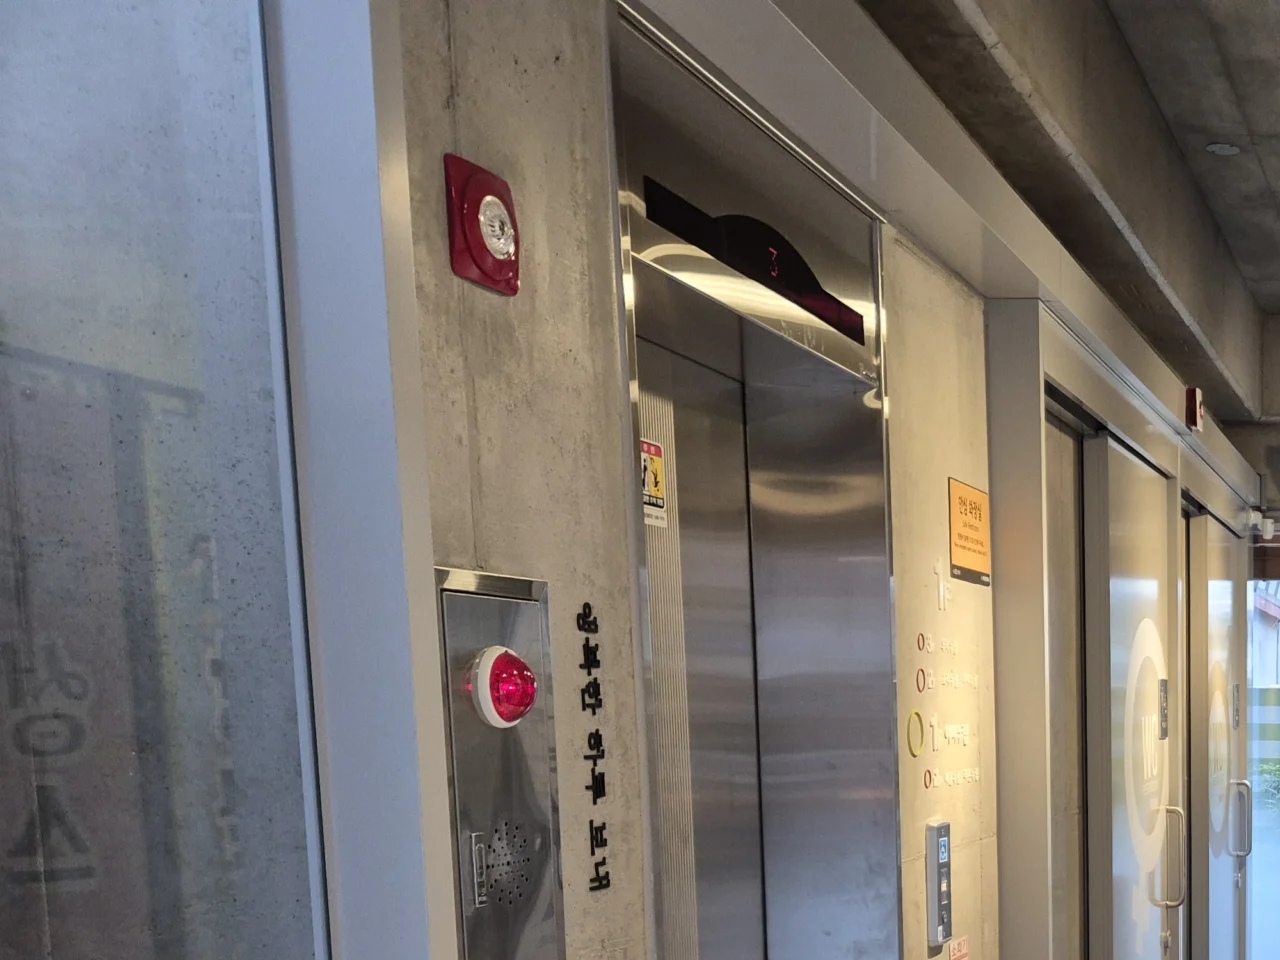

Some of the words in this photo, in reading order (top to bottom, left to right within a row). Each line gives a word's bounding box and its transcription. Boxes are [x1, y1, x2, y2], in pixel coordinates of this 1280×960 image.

[583, 728, 607, 805] 하루
[1141, 714, 1158, 780] WC
[589, 818, 612, 891] 보내
